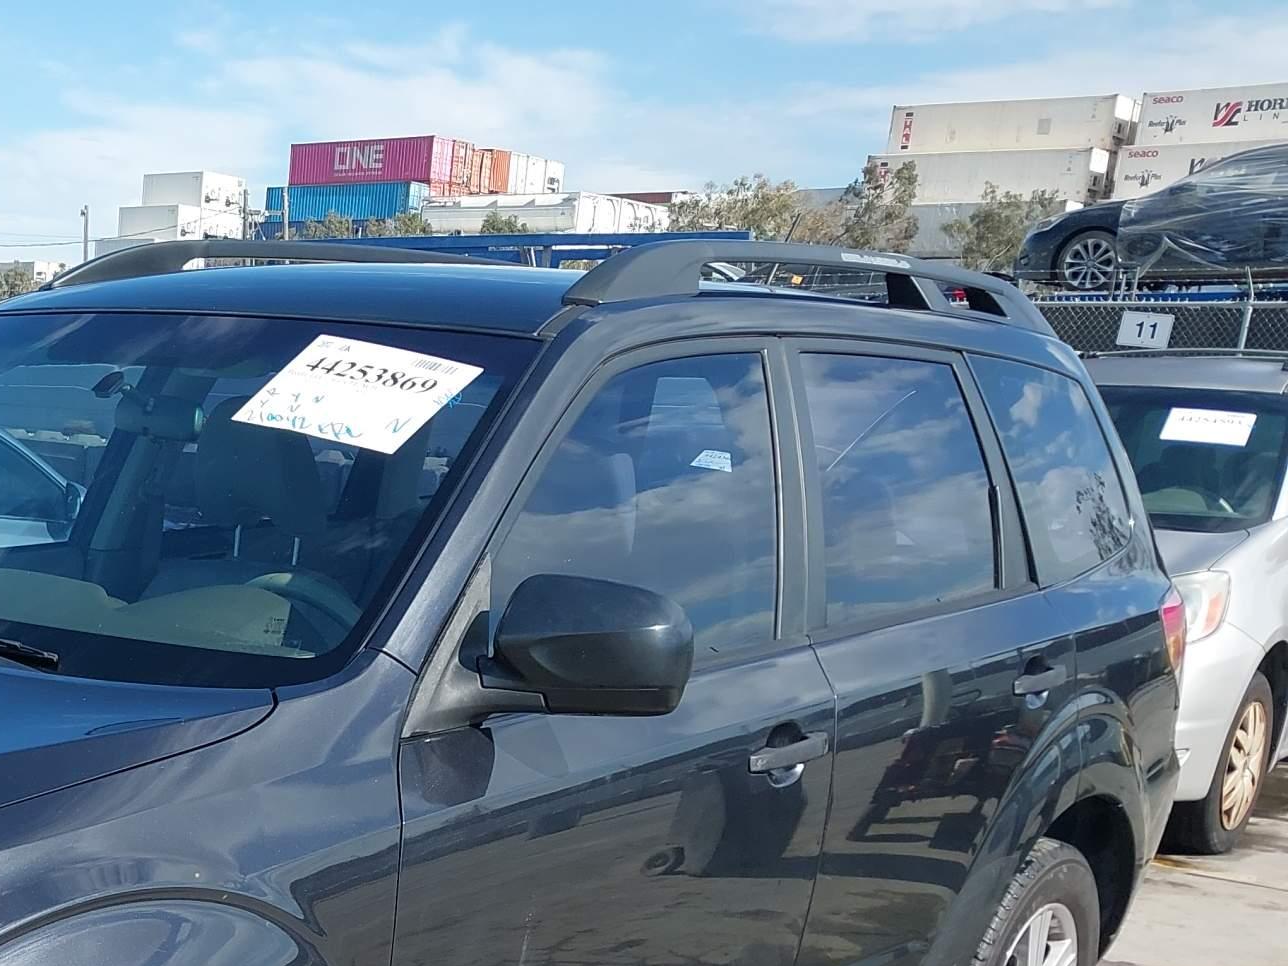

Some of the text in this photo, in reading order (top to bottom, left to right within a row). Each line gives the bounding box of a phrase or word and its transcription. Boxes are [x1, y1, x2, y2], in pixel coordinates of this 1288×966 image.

[1152, 95, 1184, 105] seaco
[333, 144, 385, 170] ONE
[1127, 149, 1159, 158] seaco
[1136, 321, 1158, 340] 11
[305, 356, 439, 394] 44253869
